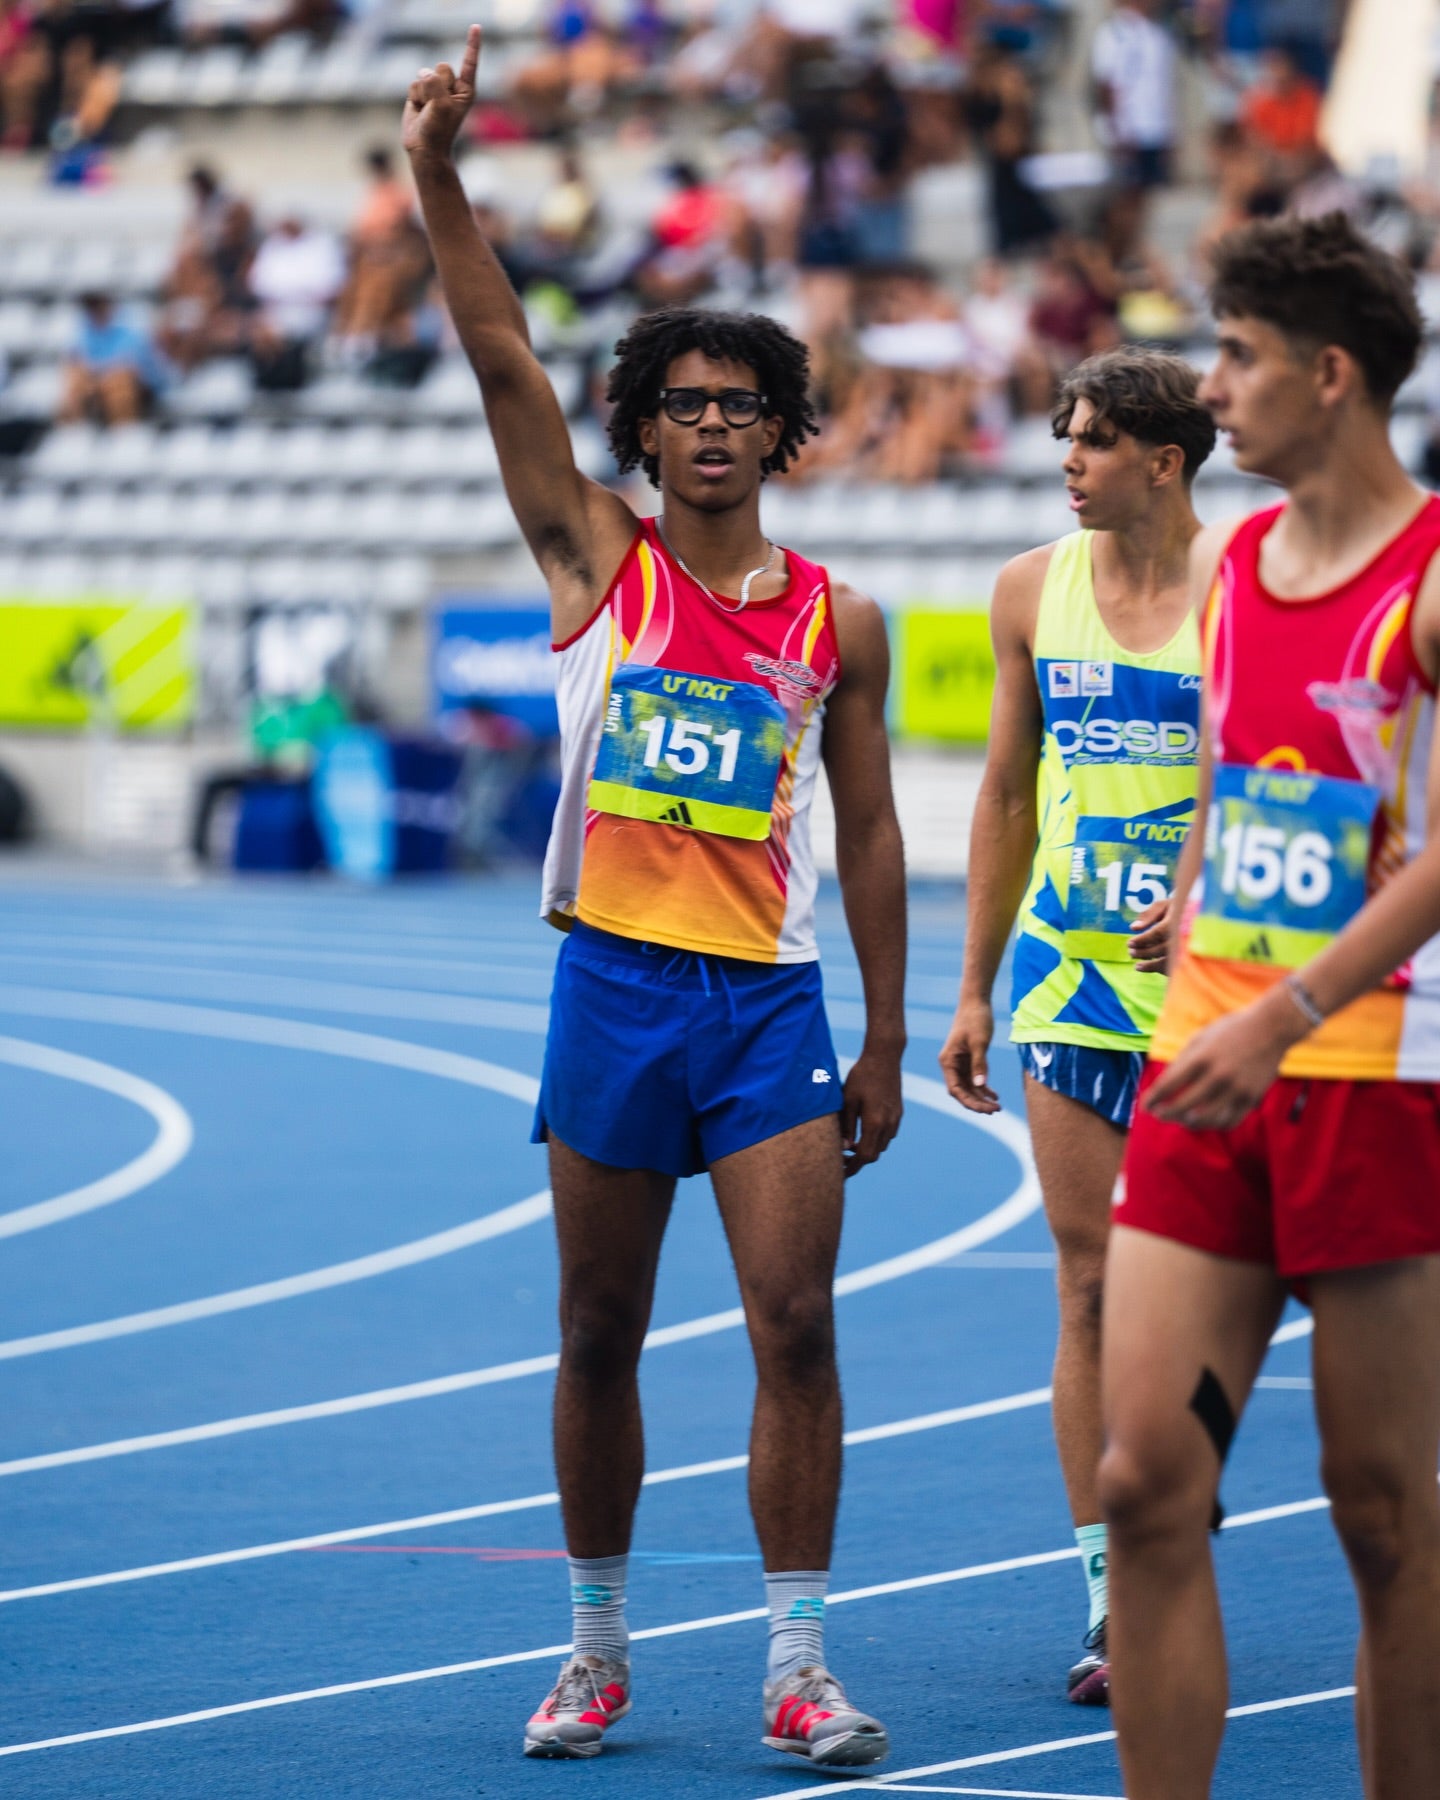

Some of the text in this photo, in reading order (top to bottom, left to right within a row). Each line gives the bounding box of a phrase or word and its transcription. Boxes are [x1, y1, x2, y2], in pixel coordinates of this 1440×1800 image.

[639, 715, 741, 782] 151
[1050, 718, 1200, 753] CSSD
[1096, 861, 1176, 913] 15
[1219, 822, 1333, 907] 156
